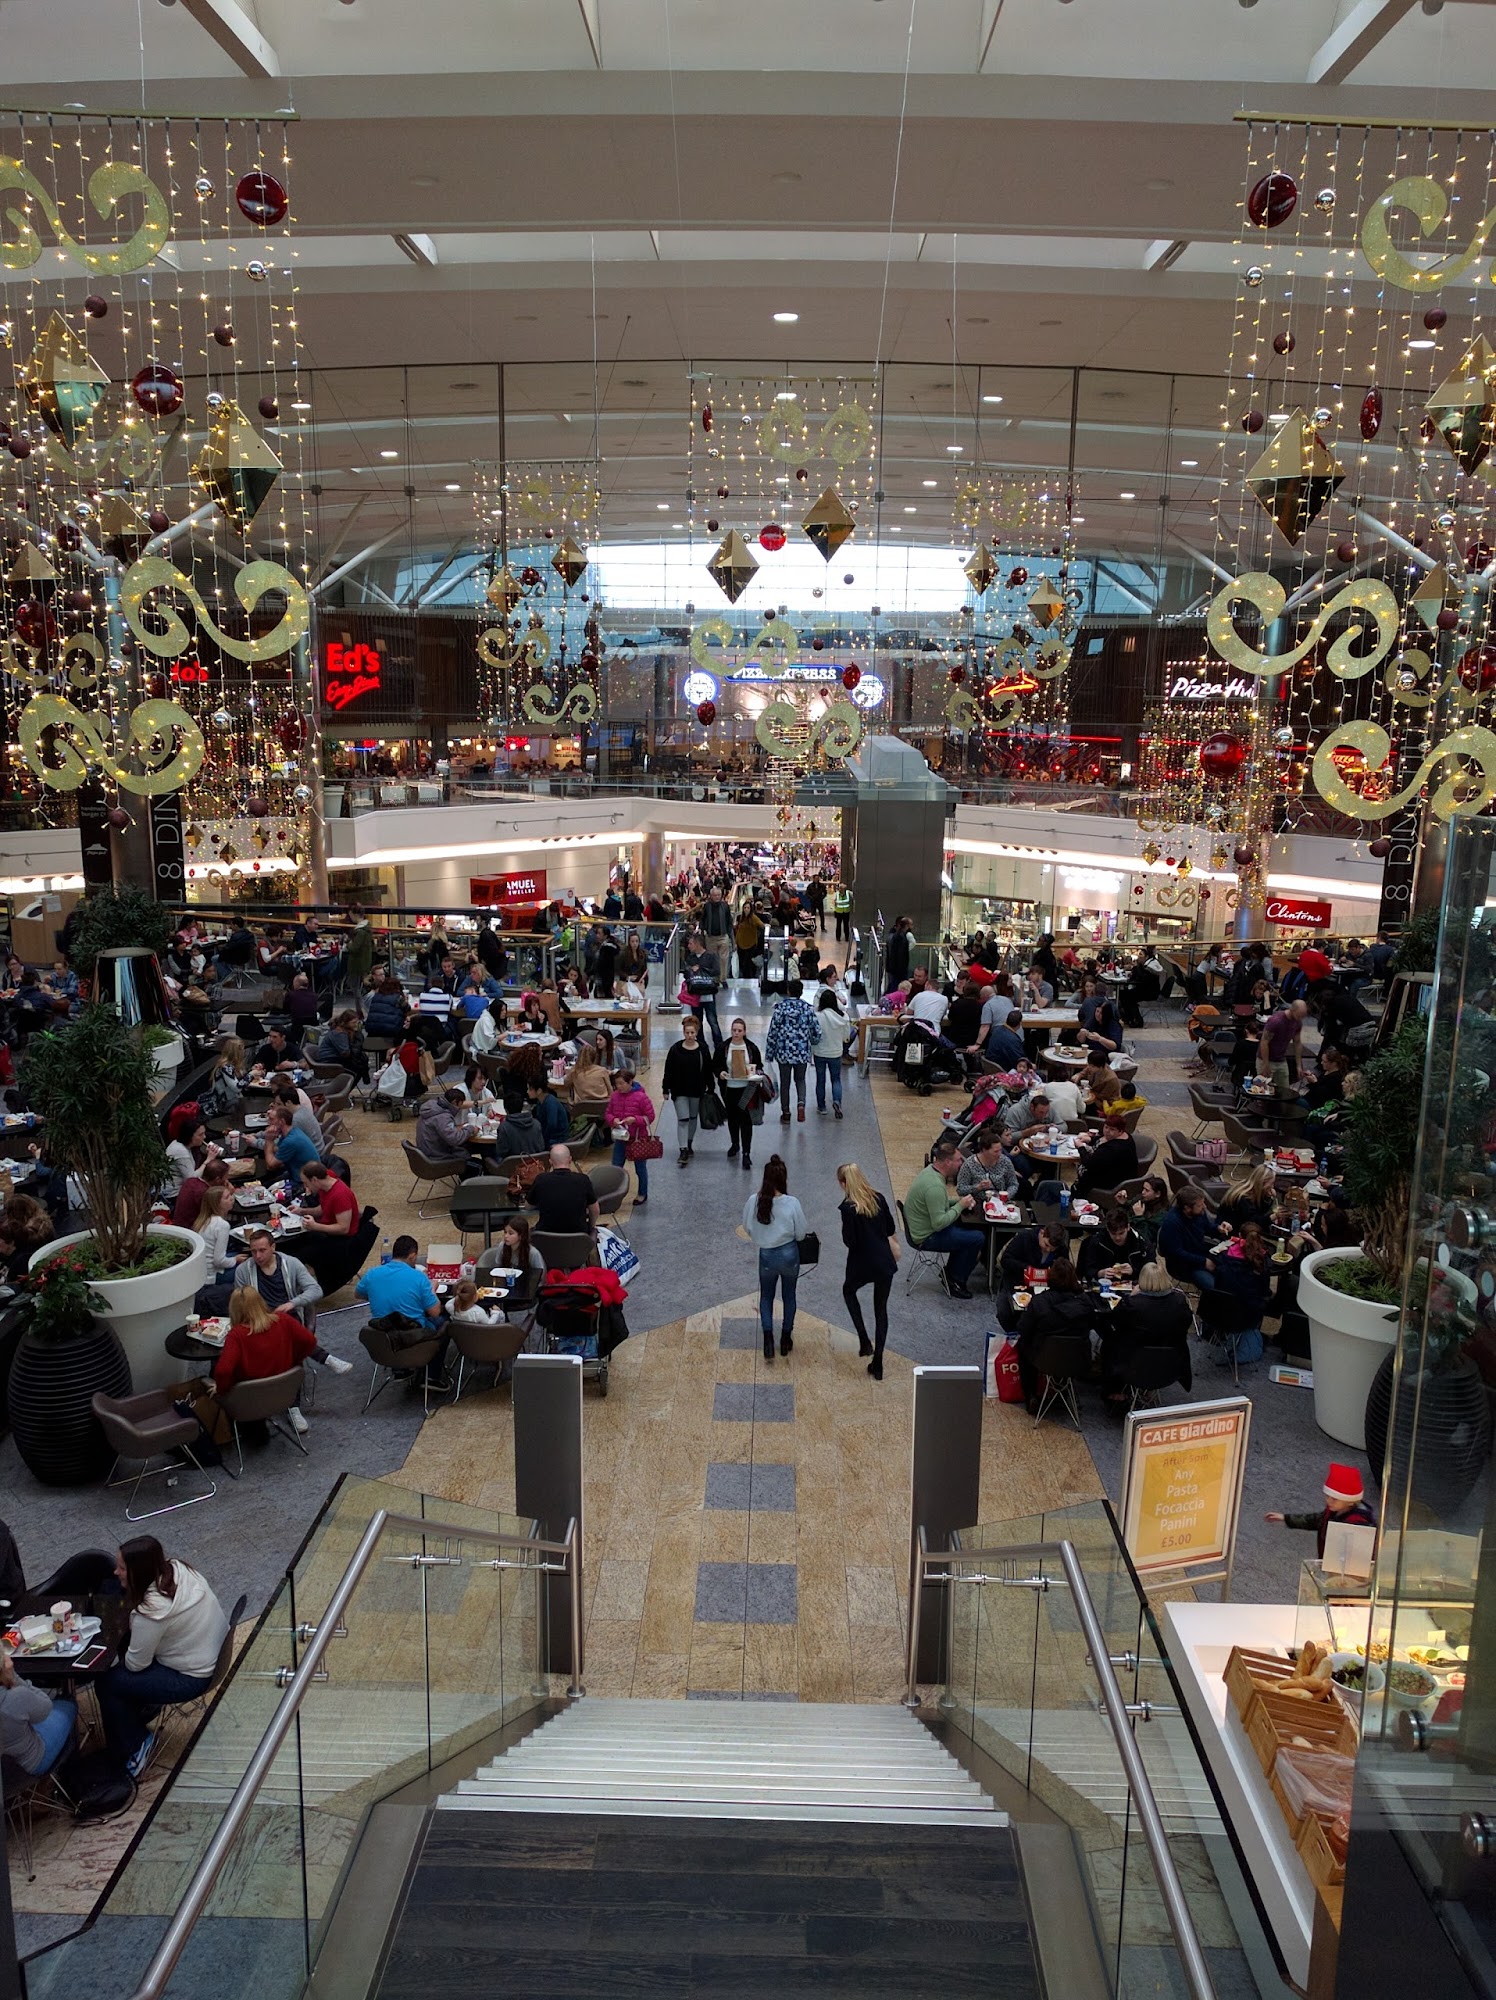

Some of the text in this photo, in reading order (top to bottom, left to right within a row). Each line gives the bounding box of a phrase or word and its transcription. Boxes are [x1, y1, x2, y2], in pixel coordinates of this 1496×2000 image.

[326, 643, 380, 672] Ed's
[1170, 677, 1255, 698] Pizza Hu
[507, 879, 536, 889] AMUEL
[1267, 902, 1322, 922] Clintons
[434, 1271, 452, 1279] KFC
[1143, 1418, 1235, 1444] CAFE giardino
[1163, 1453, 1209, 1467] After 5pm
[1174, 1469, 1194, 1482] Any
[1166, 1484, 1198, 1498] Pasta
[1154, 1498, 1205, 1516] Focaccia
[1160, 1515, 1197, 1532] Panini
[1161, 1533, 1191, 1548] £5.00
